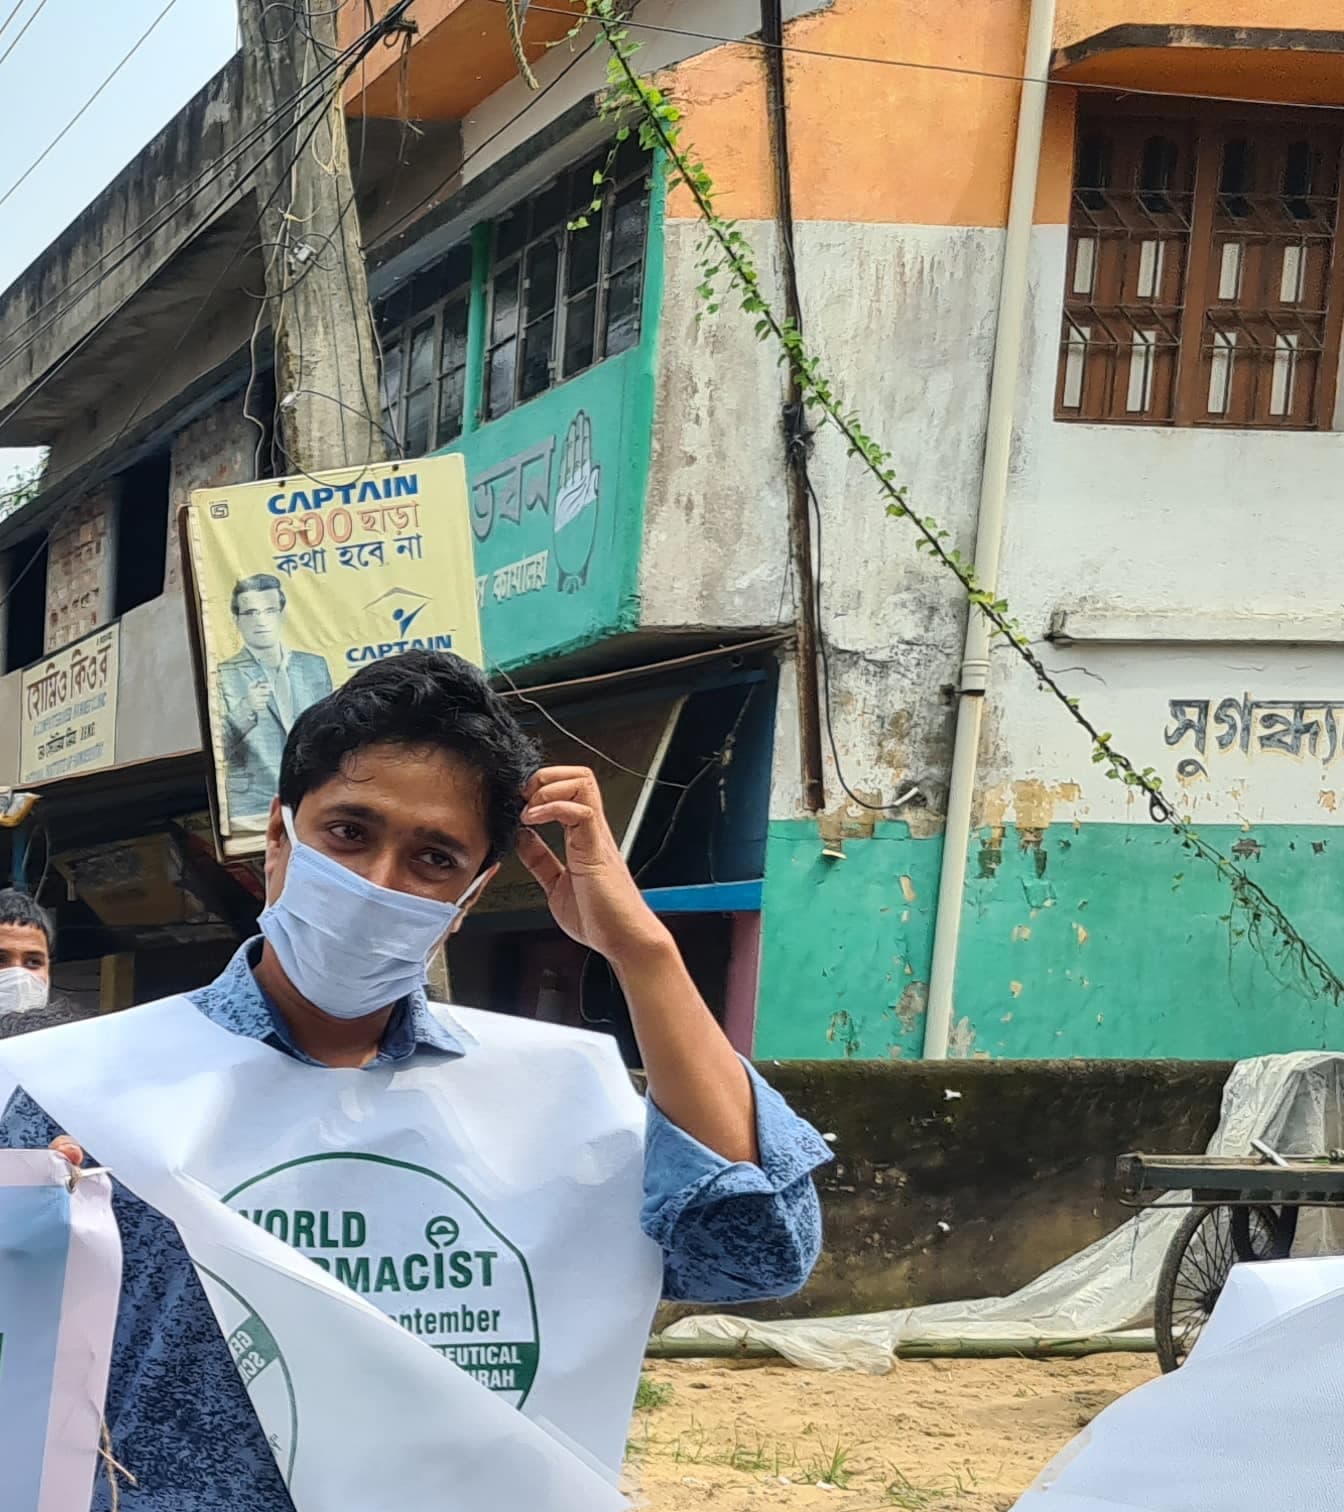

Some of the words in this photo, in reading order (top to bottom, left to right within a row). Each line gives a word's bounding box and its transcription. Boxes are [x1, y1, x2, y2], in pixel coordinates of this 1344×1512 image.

[266, 473, 419, 515] CAPTAIN
[270, 506, 354, 552] 600
[357, 501, 420, 536] ছাড়া
[272, 547, 327, 578] কথা
[335, 540, 386, 571] হবে
[393, 533, 423, 561] না
[388, 1304, 501, 1335] ptember
[436, 1345, 523, 1366] EUTICAL
